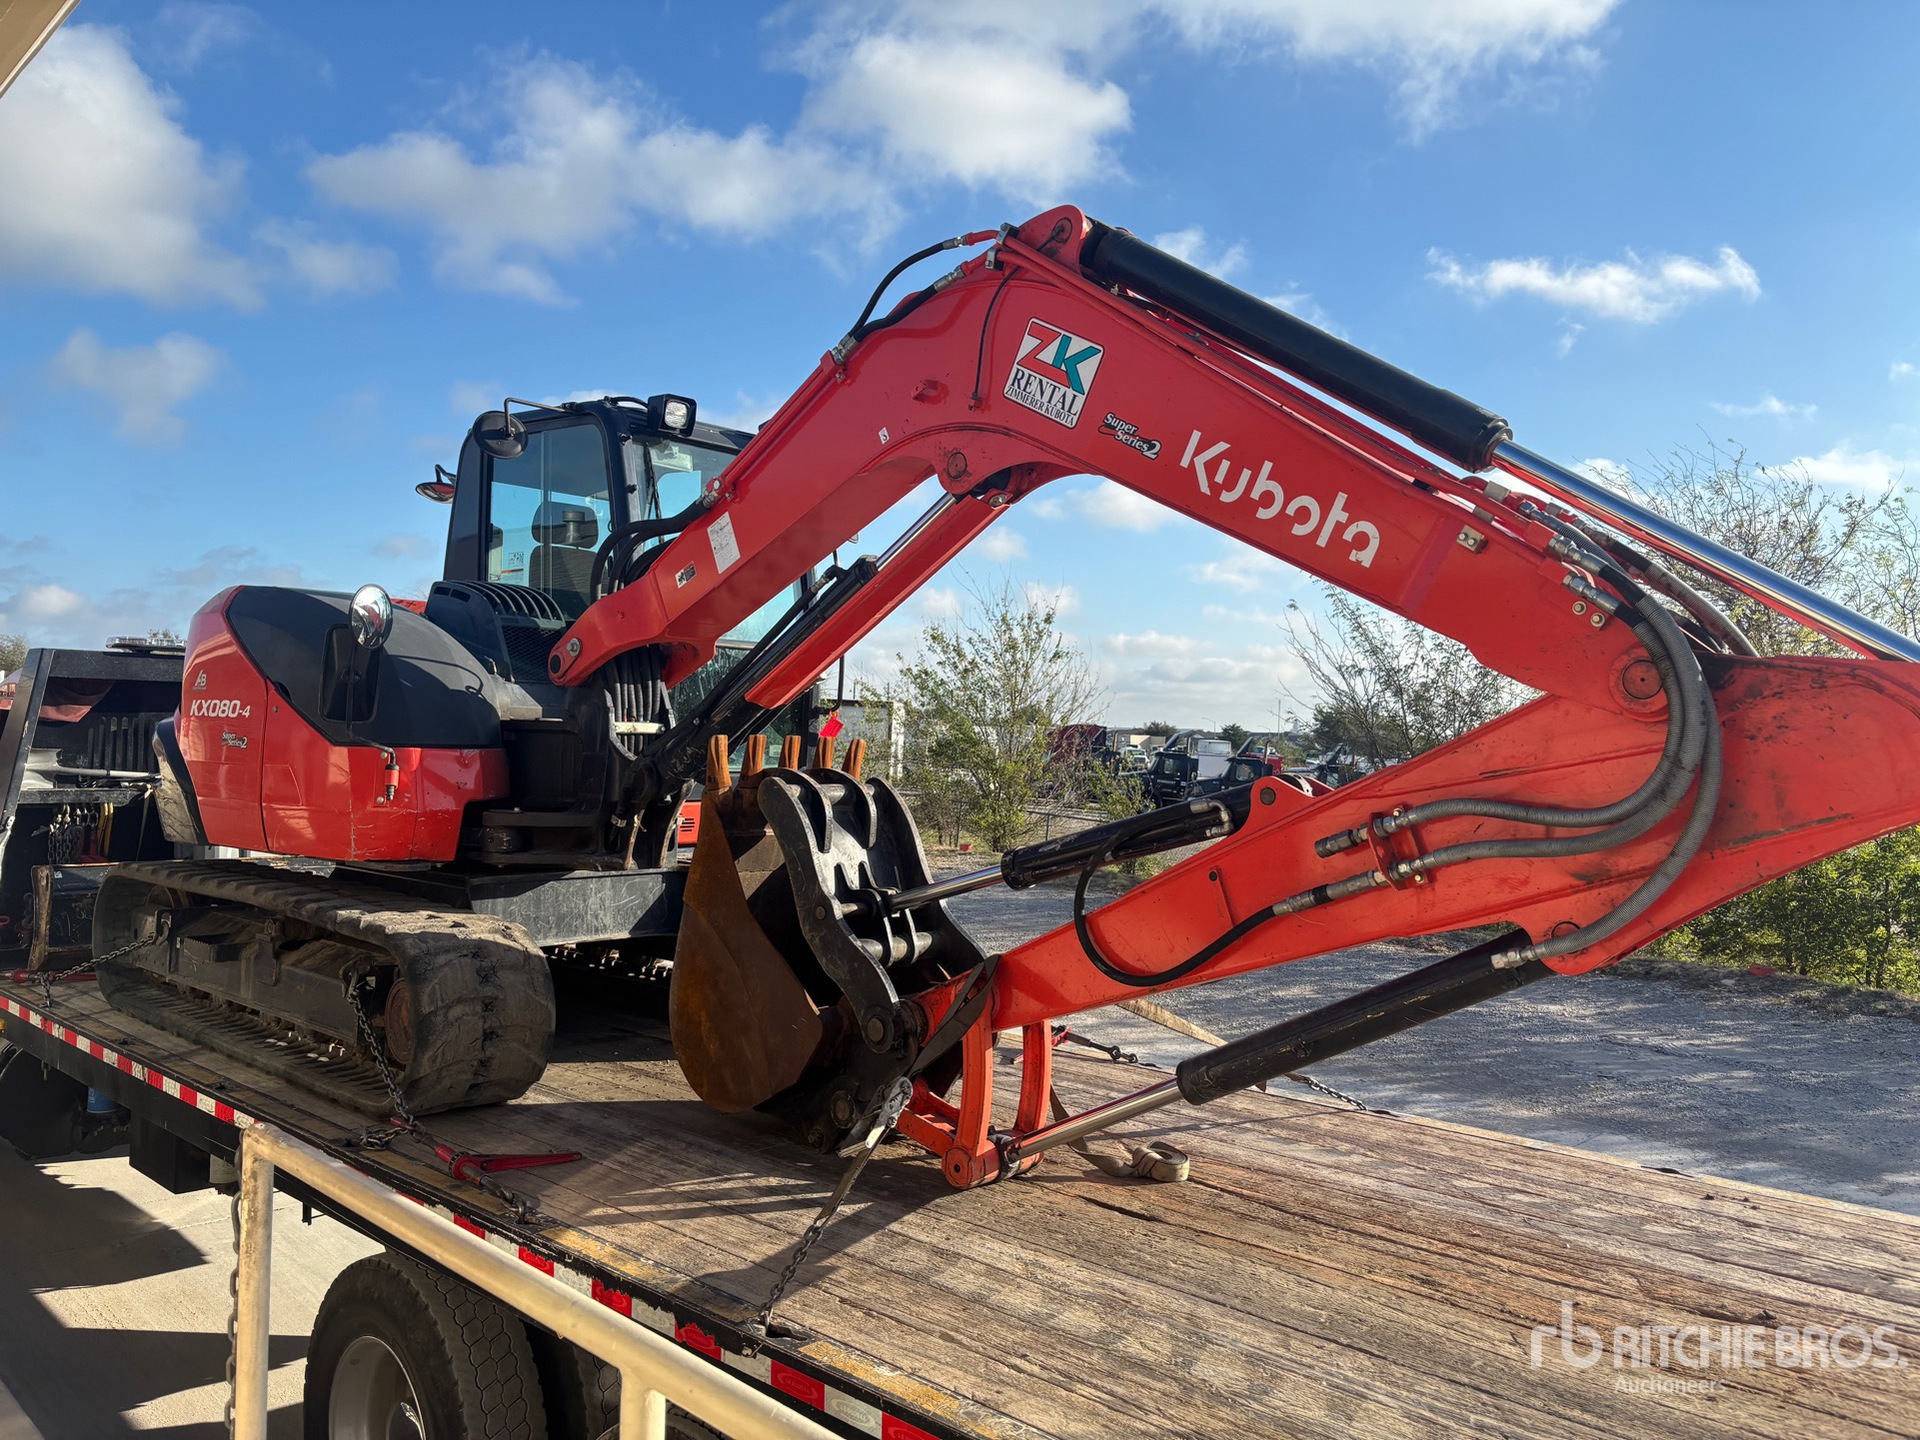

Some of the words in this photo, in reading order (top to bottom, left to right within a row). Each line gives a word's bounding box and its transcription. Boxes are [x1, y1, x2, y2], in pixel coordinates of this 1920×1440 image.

[1016, 321, 1102, 396] ZK
[1005, 385, 1045, 412] ZIMMERER
[1044, 403, 1076, 427] KUBOTA
[1010, 367, 1079, 417] RENTAL
[1103, 413, 1138, 436] Super
[1179, 429, 1381, 569] Kubota
[190, 699, 251, 718] KX080-4
